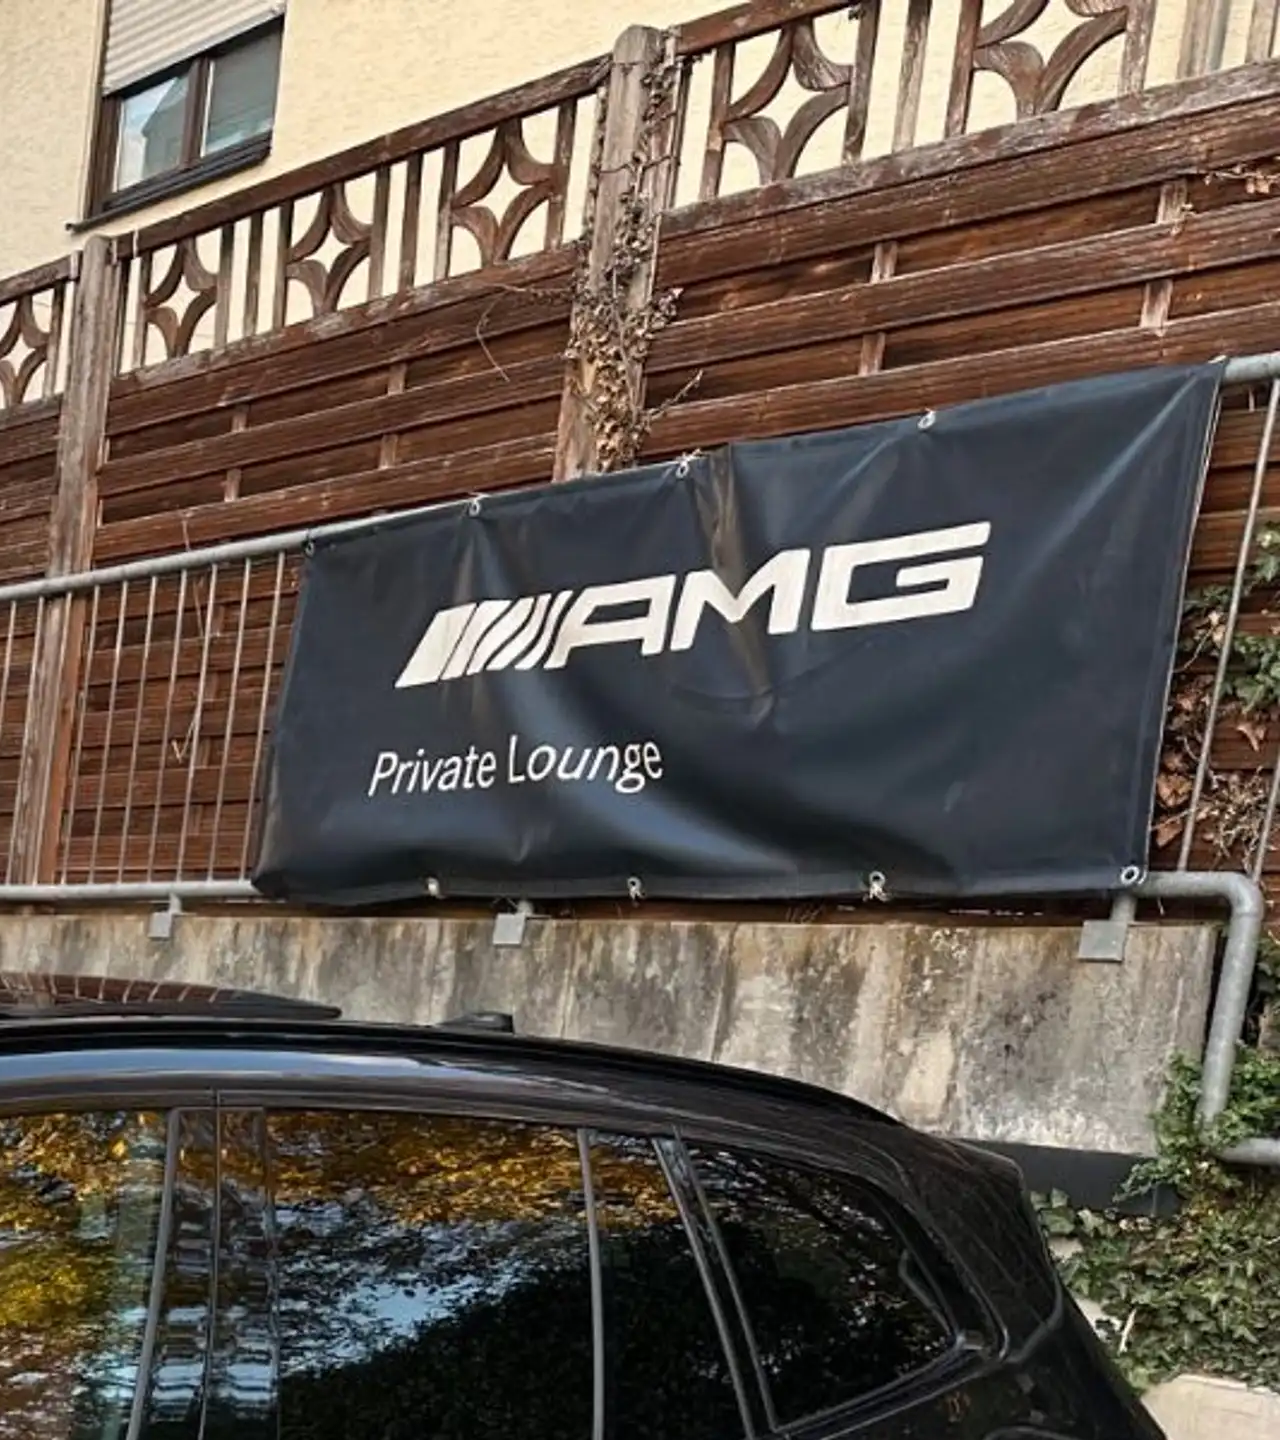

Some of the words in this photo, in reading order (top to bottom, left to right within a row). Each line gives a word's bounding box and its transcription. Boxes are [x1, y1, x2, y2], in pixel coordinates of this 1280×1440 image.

[544, 521, 991, 669] AMG
[368, 745, 497, 797] Private
[507, 734, 663, 794] Lounge
